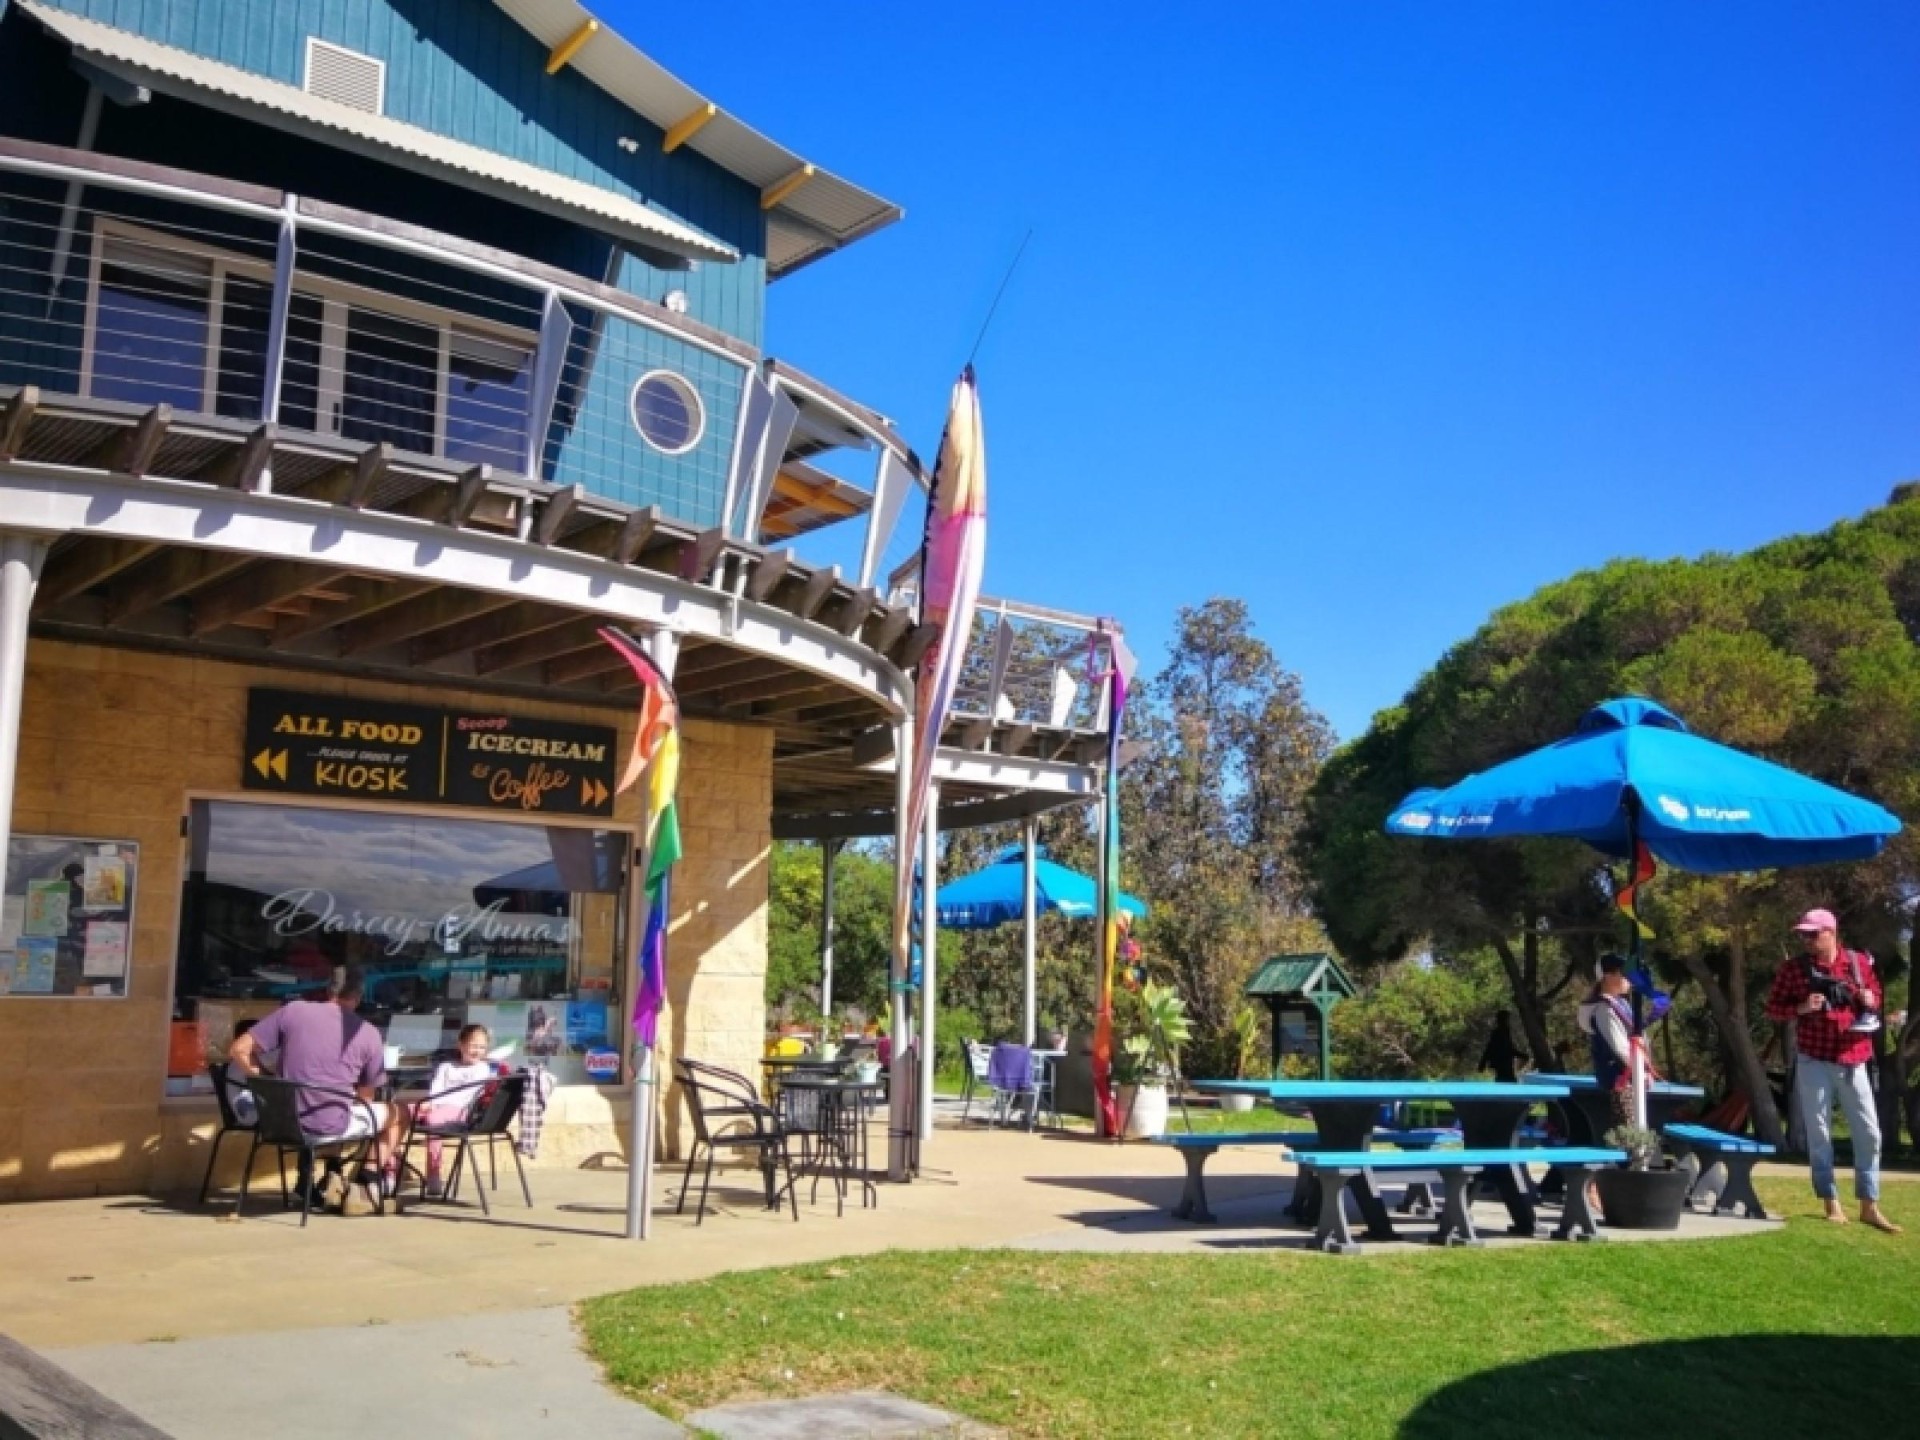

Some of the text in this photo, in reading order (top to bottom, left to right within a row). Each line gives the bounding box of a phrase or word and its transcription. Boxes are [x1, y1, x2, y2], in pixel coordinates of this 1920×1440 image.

[273, 714, 422, 745] ALL FOOD
[467, 731, 606, 761] ICECREAM
[316, 759, 409, 791] KIOSK
[489, 761, 571, 810] Coffee
